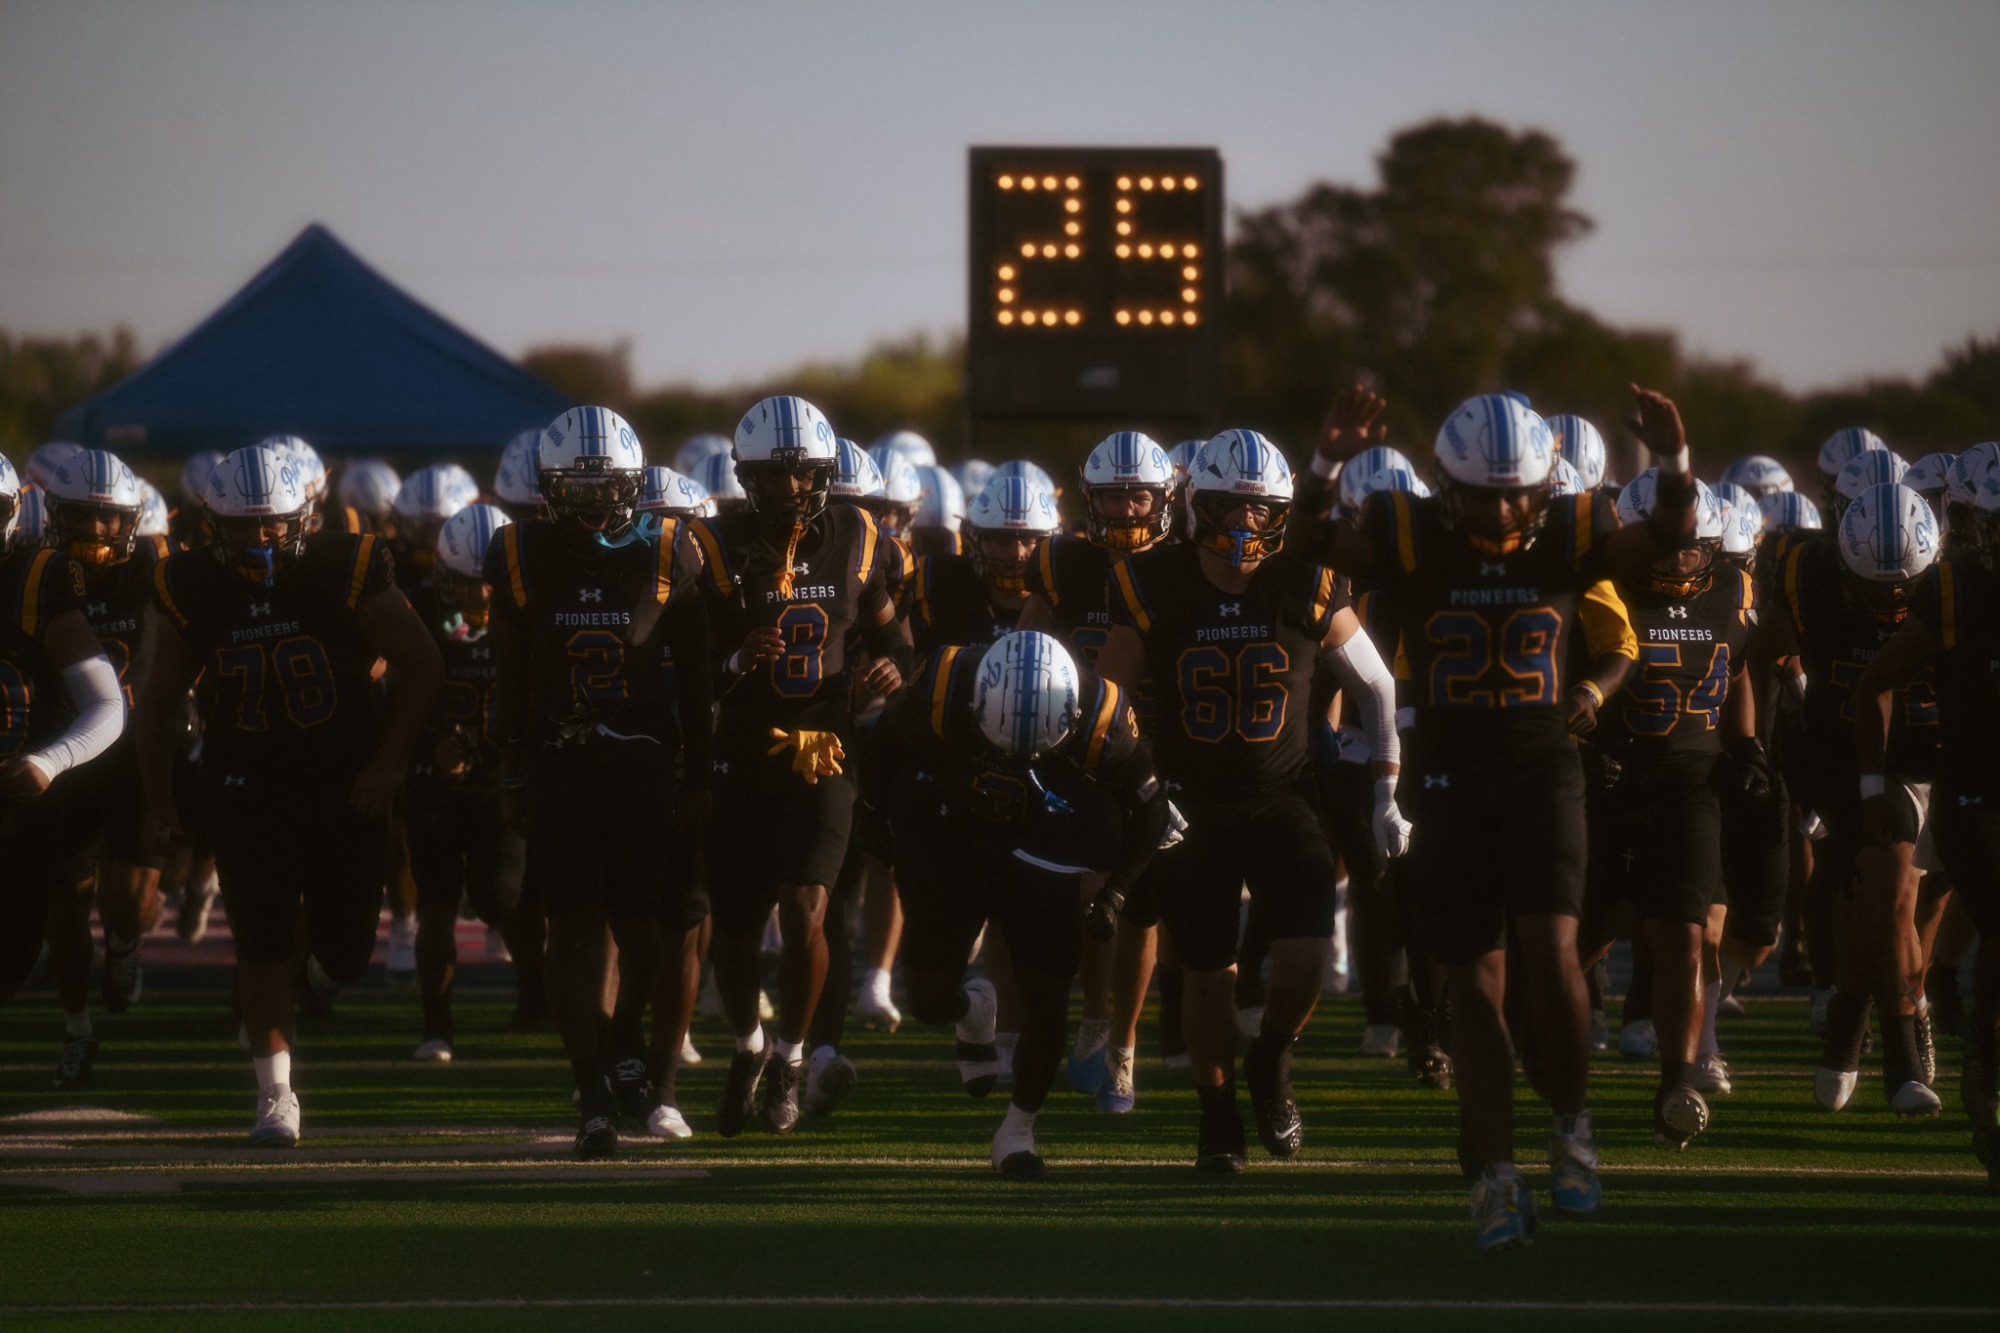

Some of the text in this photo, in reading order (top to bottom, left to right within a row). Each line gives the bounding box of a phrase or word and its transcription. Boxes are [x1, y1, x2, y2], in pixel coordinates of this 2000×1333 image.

[996, 174, 1199, 327] 25
[1234, 482, 1266, 493] Riddell
[766, 585, 836, 604] PINEERS
[1451, 588, 1539, 605] PIONEERS
[232, 621, 300, 643] PIONEERS
[555, 612, 630, 626] PIONEERS
[1196, 625, 1269, 642] PIONEERS
[1649, 628, 1713, 641] PIONEERS
[566, 629, 630, 703] 2
[770, 602, 829, 698] 8
[1423, 605, 1564, 709] 29
[215, 634, 338, 732] 78
[1177, 642, 1290, 744] 66
[1621, 642, 1731, 737] 54
